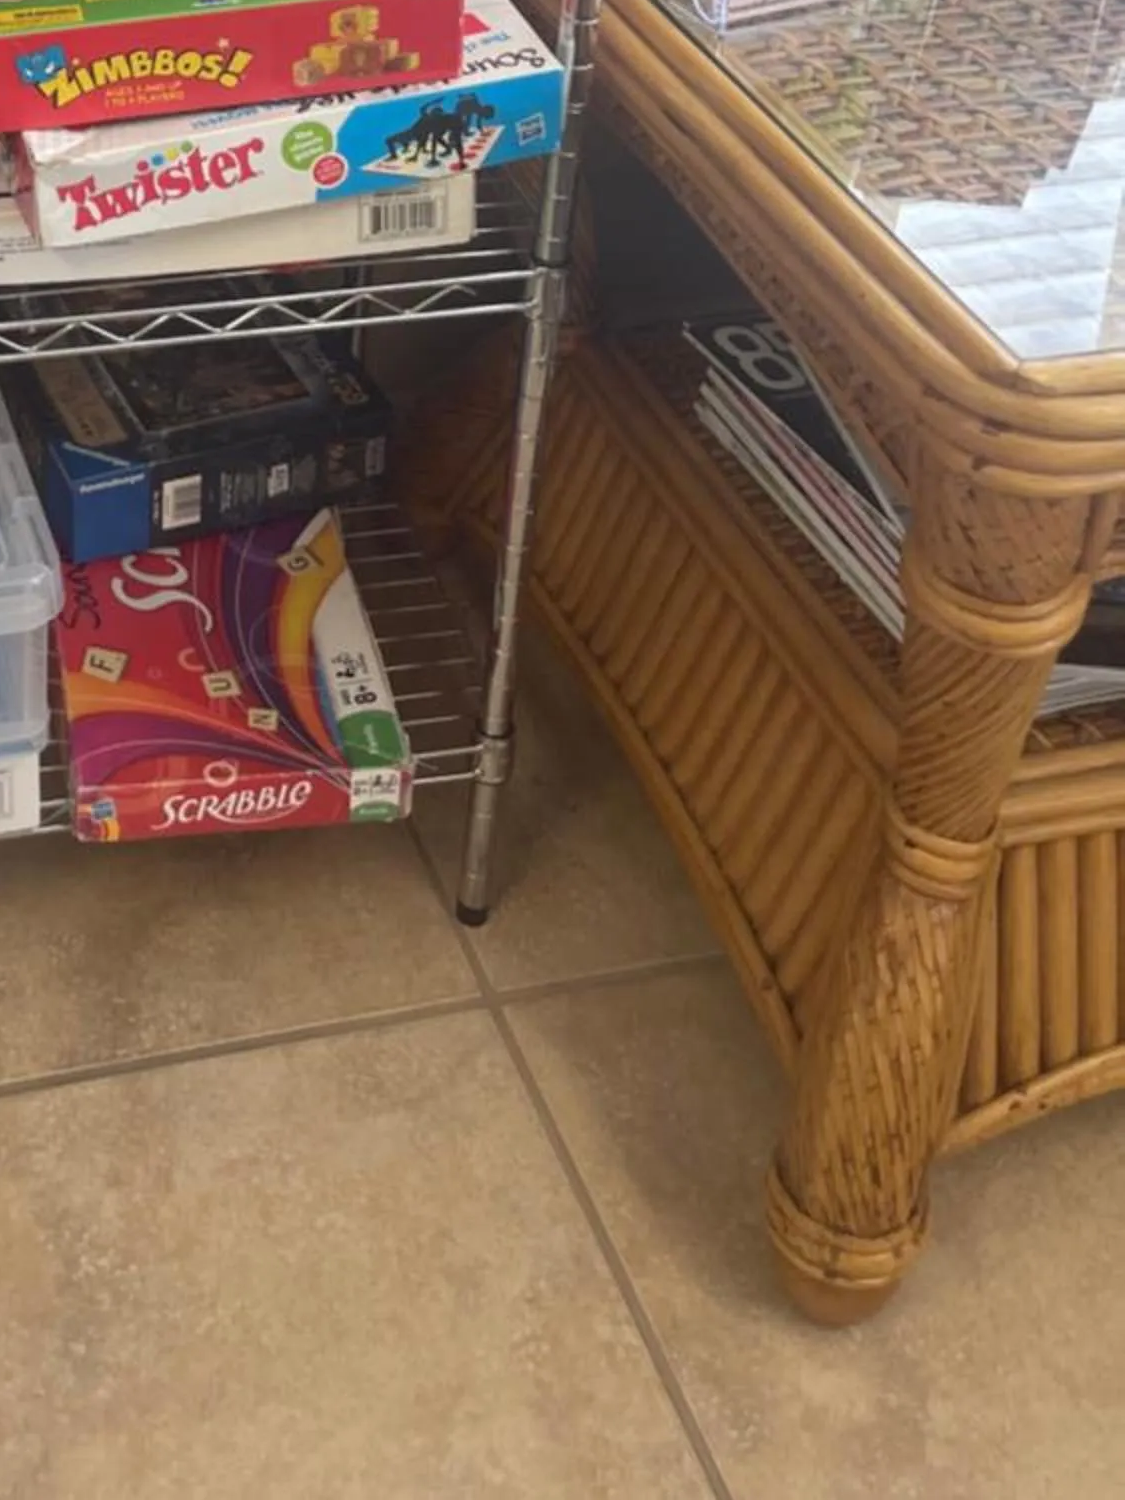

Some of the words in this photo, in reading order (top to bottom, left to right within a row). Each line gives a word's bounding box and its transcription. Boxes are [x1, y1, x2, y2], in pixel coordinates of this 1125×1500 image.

[40, 47, 254, 109] ZIMBBOS!
[56, 138, 264, 230] Twister
[152, 779, 314, 831] SCRABBLE
